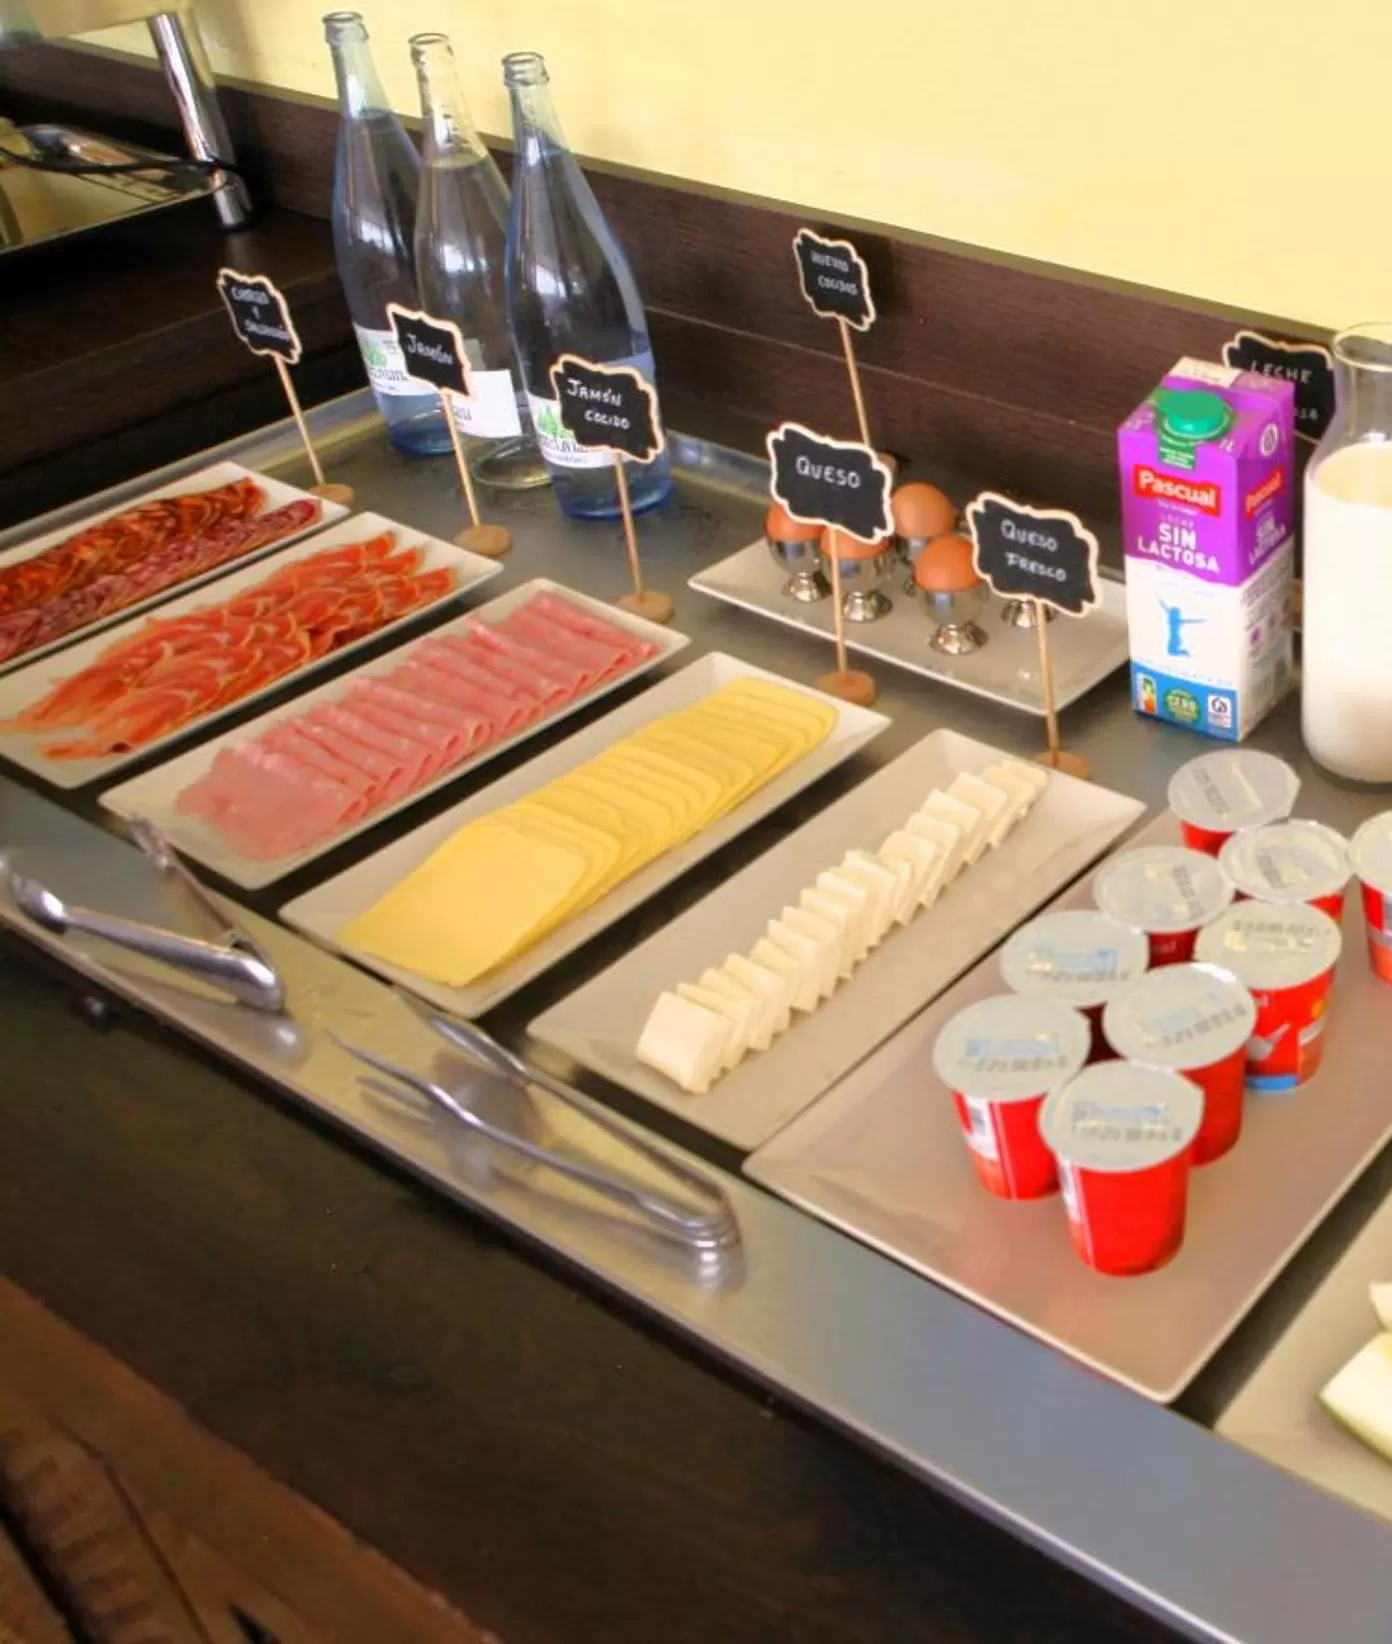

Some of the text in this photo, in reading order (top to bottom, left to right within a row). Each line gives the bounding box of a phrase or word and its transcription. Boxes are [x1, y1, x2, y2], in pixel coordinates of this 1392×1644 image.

[567, 378, 622, 407] JAMÓN
[584, 409, 631, 430] COCIDO
[796, 456, 861, 488] QUESO
[1138, 470, 1217, 508] Pascual
[1001, 519, 1058, 552] QUESO
[1158, 522, 1197, 551] SIN
[1004, 551, 1067, 582] FRESCO
[1137, 533, 1220, 574] LACTOSA
